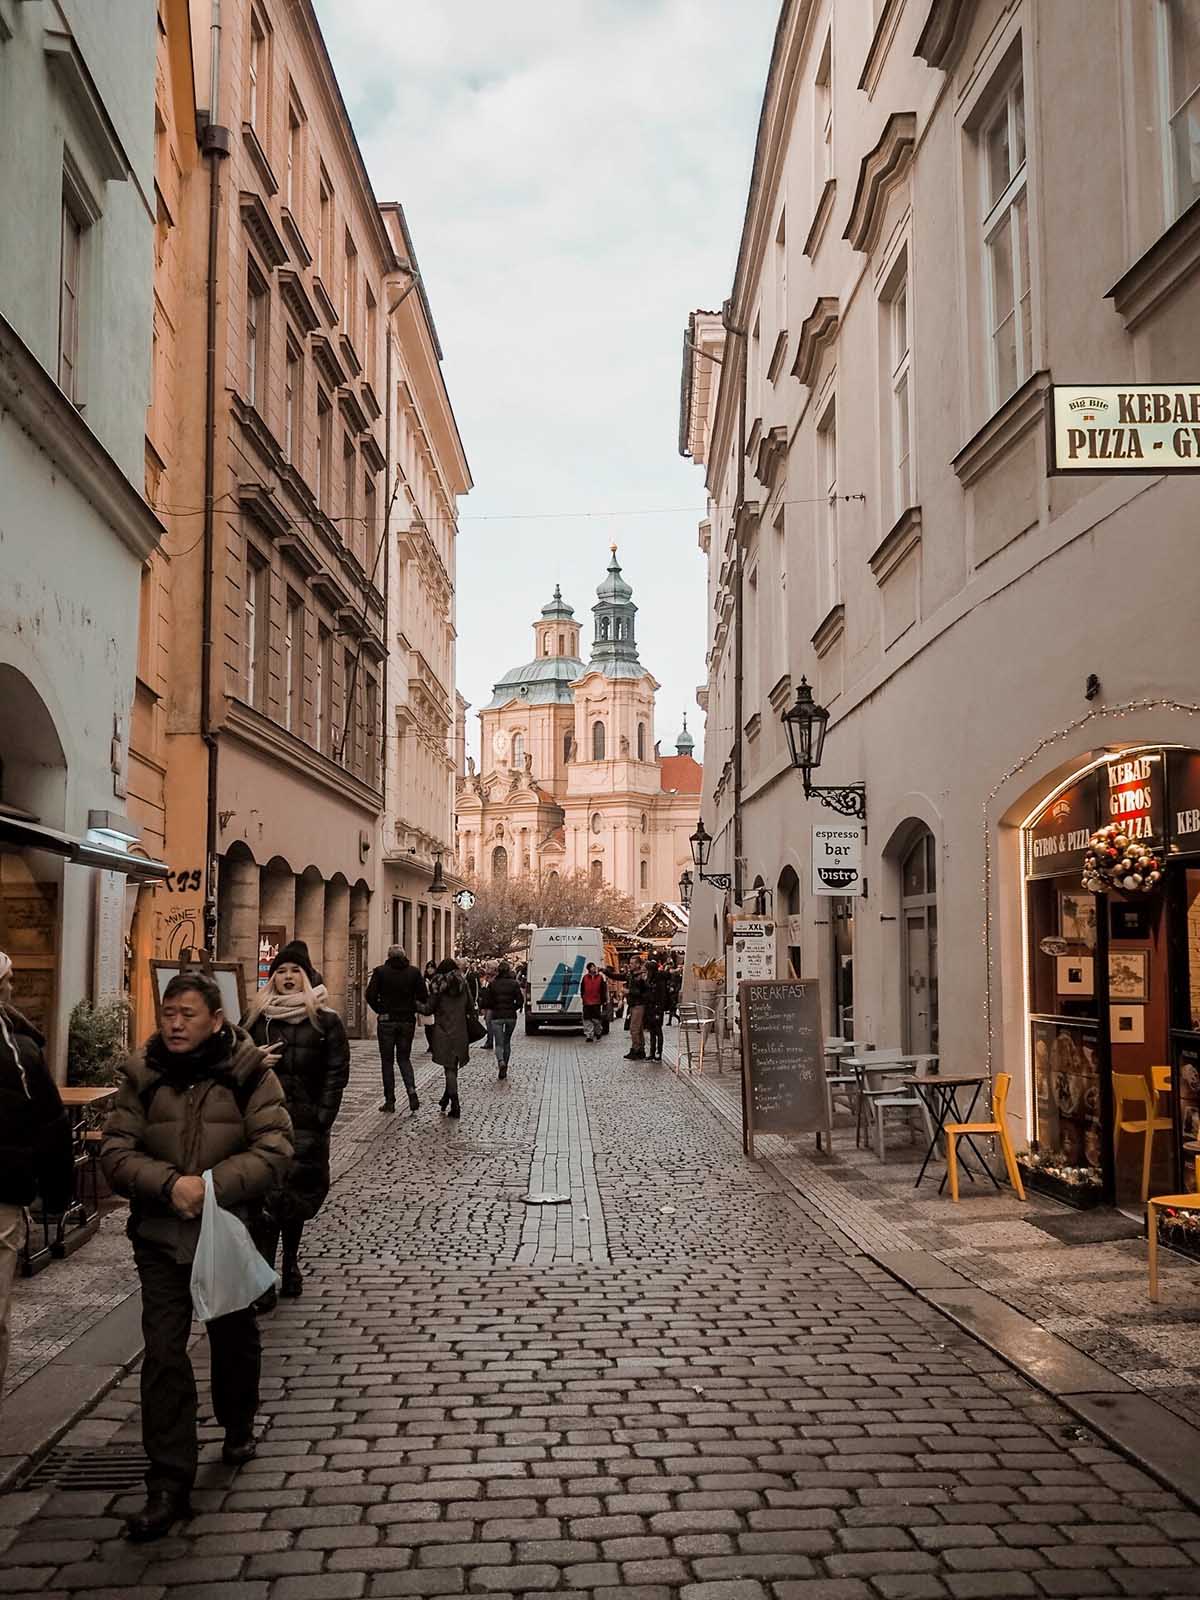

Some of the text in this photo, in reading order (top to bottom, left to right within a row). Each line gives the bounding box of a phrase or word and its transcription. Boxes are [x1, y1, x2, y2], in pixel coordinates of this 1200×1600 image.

[1068, 400, 1086, 411] Big
[1067, 428, 1144, 458] PIZZA
[1108, 759, 1152, 787] KEBAB
[1110, 787, 1152, 815] GYROS
[815, 831, 859, 840] espresso
[825, 842, 850, 855] bar
[1034, 834, 1057, 858] GYROS
[821, 868, 857, 880] bistro
[748, 923, 763, 931] XXL
[750, 984, 807, 1001] BREAKFAST
